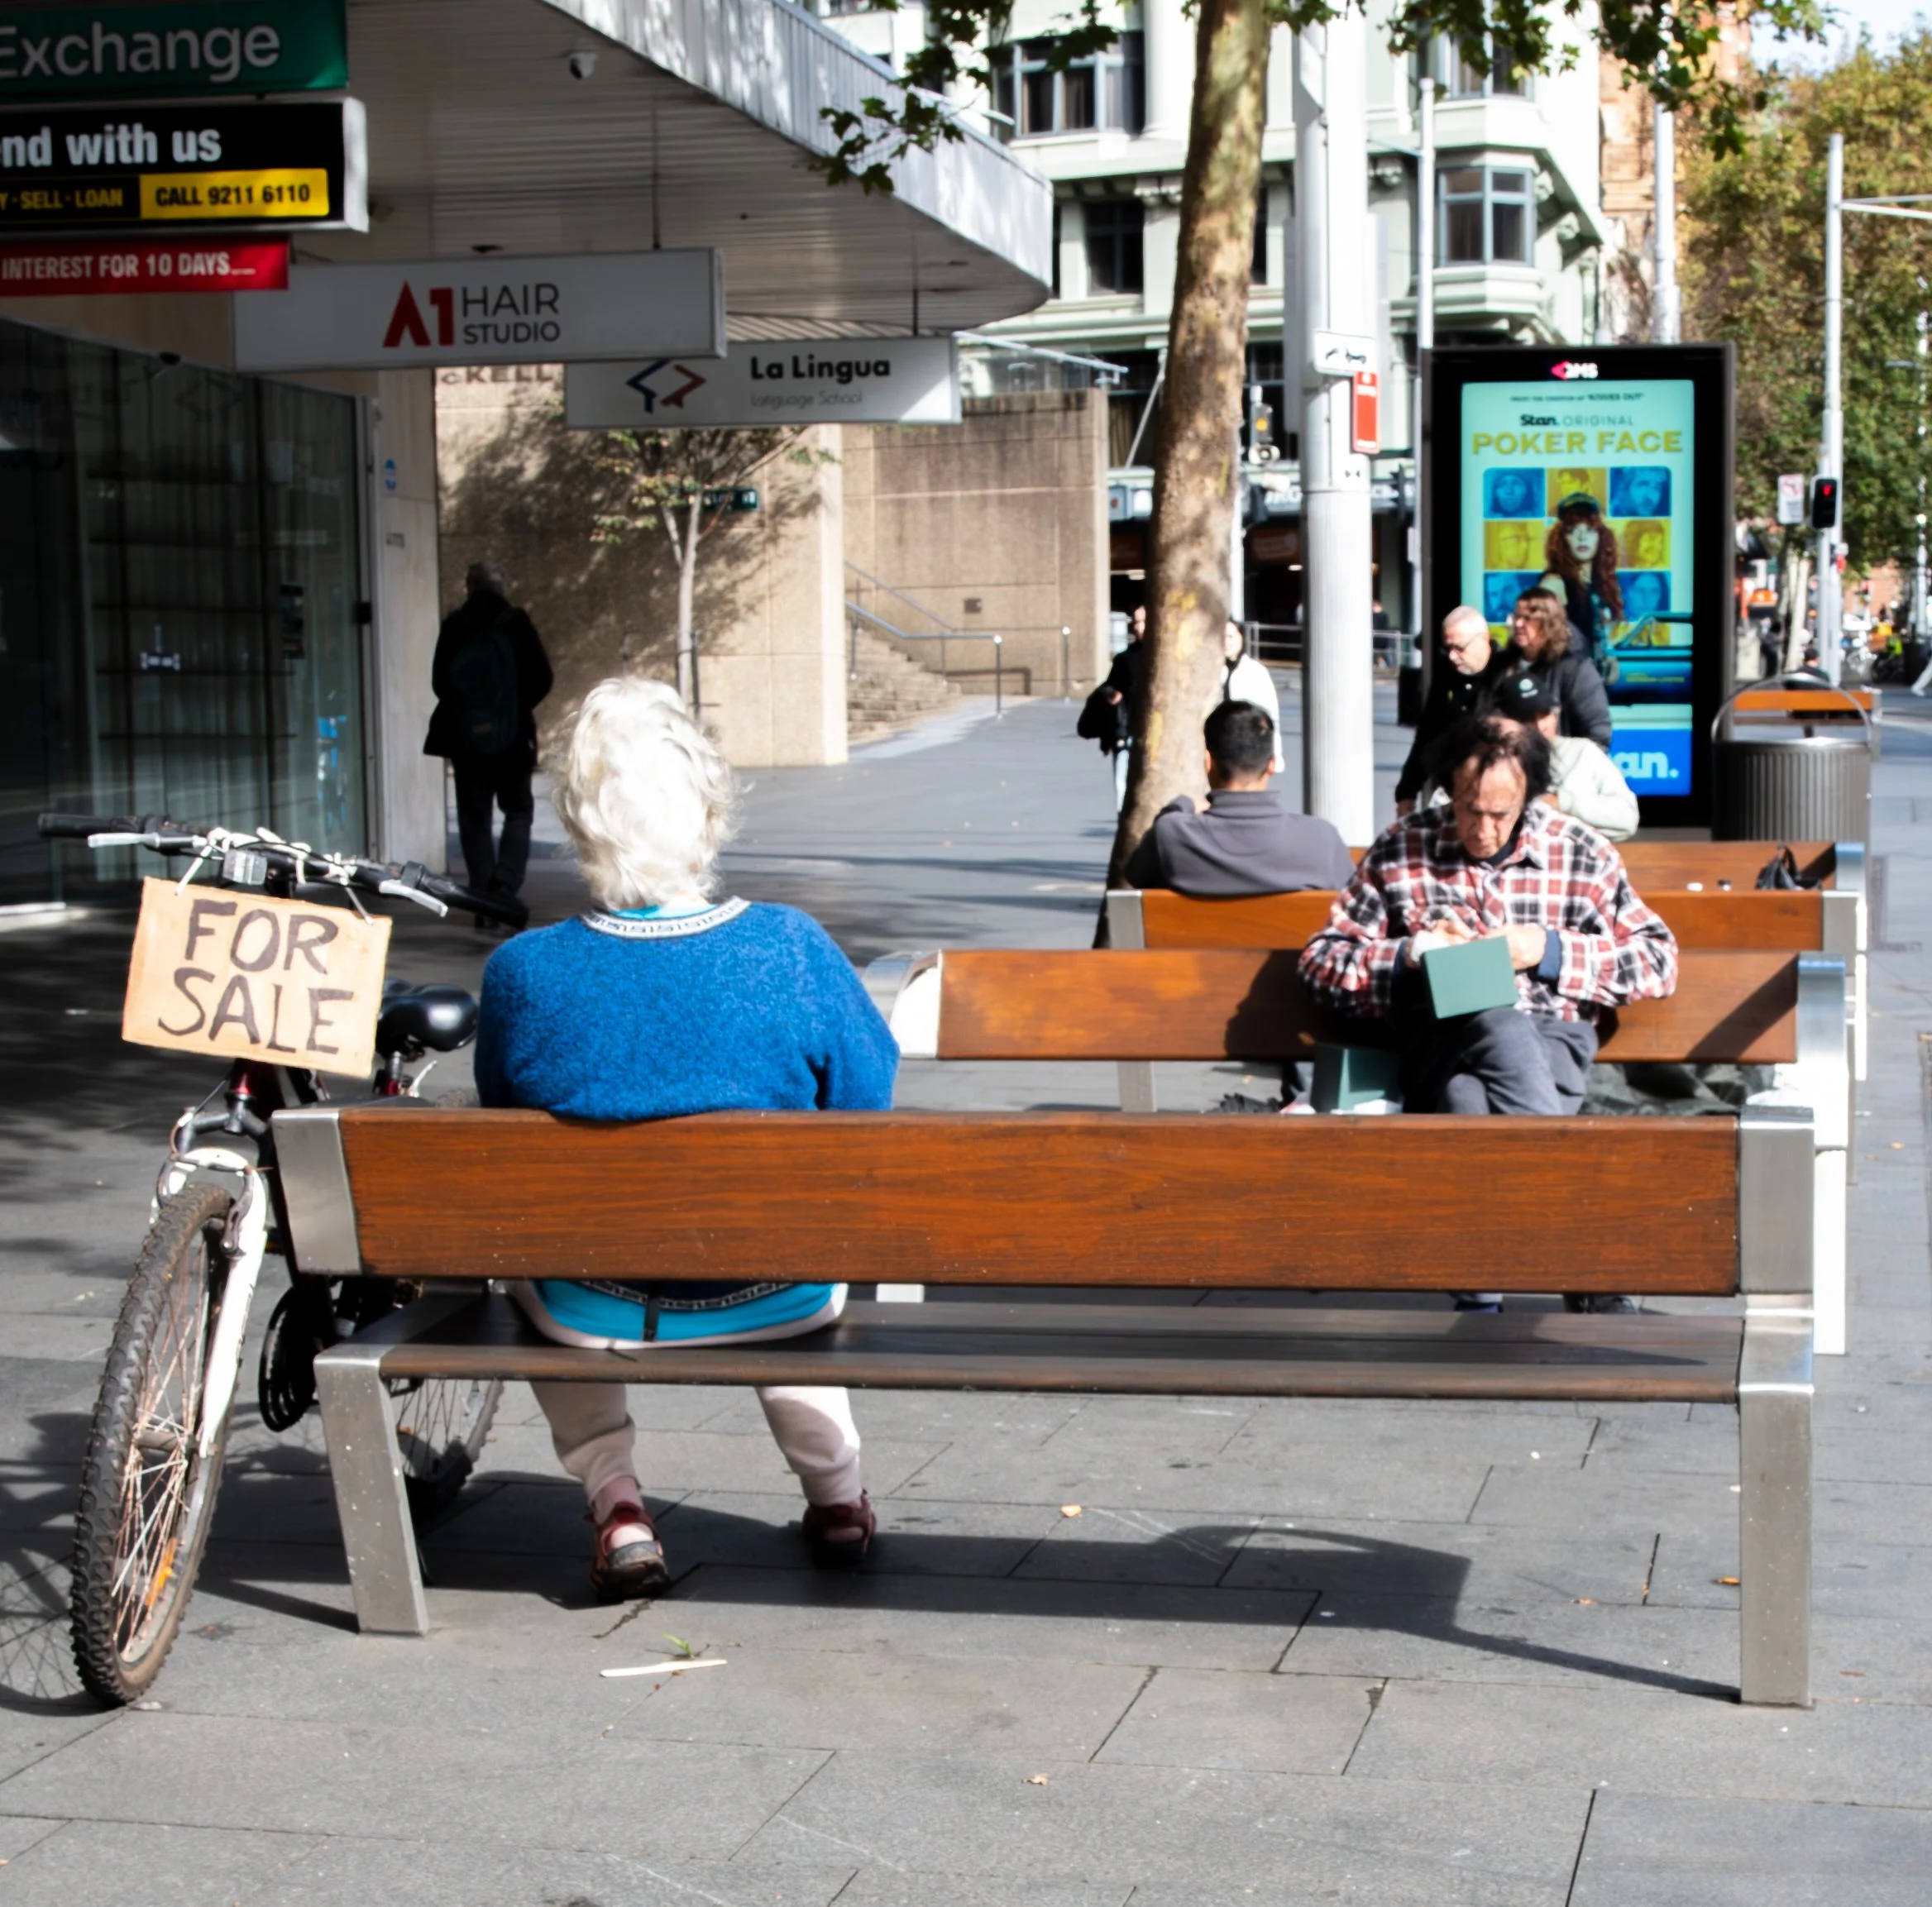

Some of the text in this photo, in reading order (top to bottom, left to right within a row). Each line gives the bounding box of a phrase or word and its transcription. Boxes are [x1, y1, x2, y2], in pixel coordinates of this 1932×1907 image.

[0, 22, 280, 82] Exchange
[0, 123, 222, 167] nd with us
[21, 191, 63, 210] SELL
[75, 189, 123, 207] LOAN
[155, 186, 202, 207] CALL
[208, 185, 253, 206] 9211
[262, 184, 310, 203] 6110
[2, 254, 94, 280] INTEREST
[99, 253, 139, 278] FOR
[146, 253, 172, 277] 10
[383, 281, 559, 347] A1 HAIR
[464, 321, 561, 345] STUDIO
[751, 354, 890, 385] La Lingua
[819, 390, 863, 405] School
[1562, 414, 1634, 427] ORIGINAL
[1471, 429, 1683, 455] POKER FACE
[1609, 751, 1680, 779] an.
[184, 898, 339, 974] FOR
[158, 967, 354, 1054] SALE
